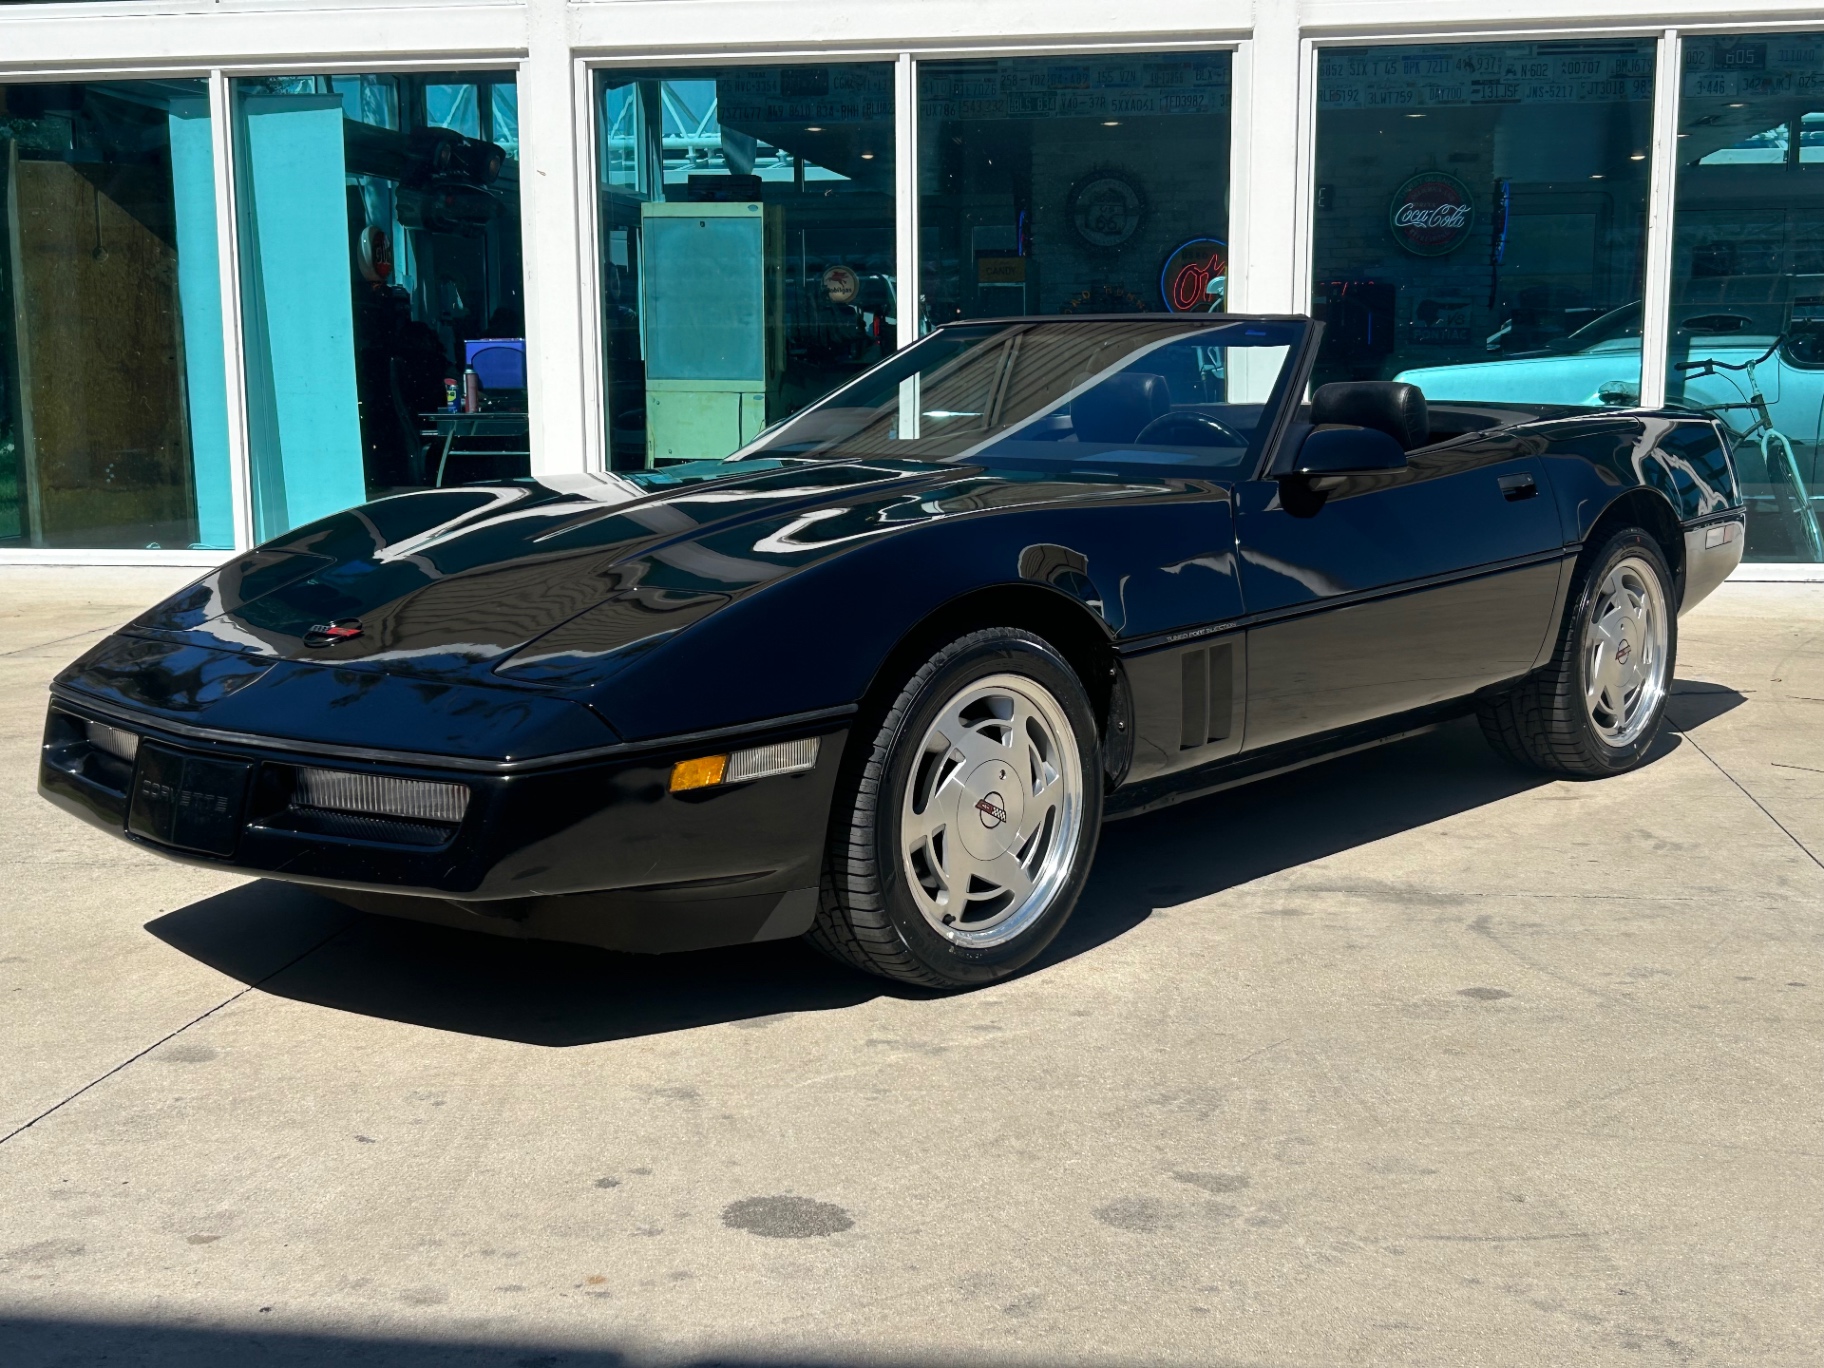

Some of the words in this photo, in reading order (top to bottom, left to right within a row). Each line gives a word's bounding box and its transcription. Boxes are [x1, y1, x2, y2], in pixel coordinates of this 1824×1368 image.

[1395, 202, 1471, 229] Coca-Cola
[1413, 328, 1467, 341] PONTIAC
[143, 779, 228, 813] CORVETTE
